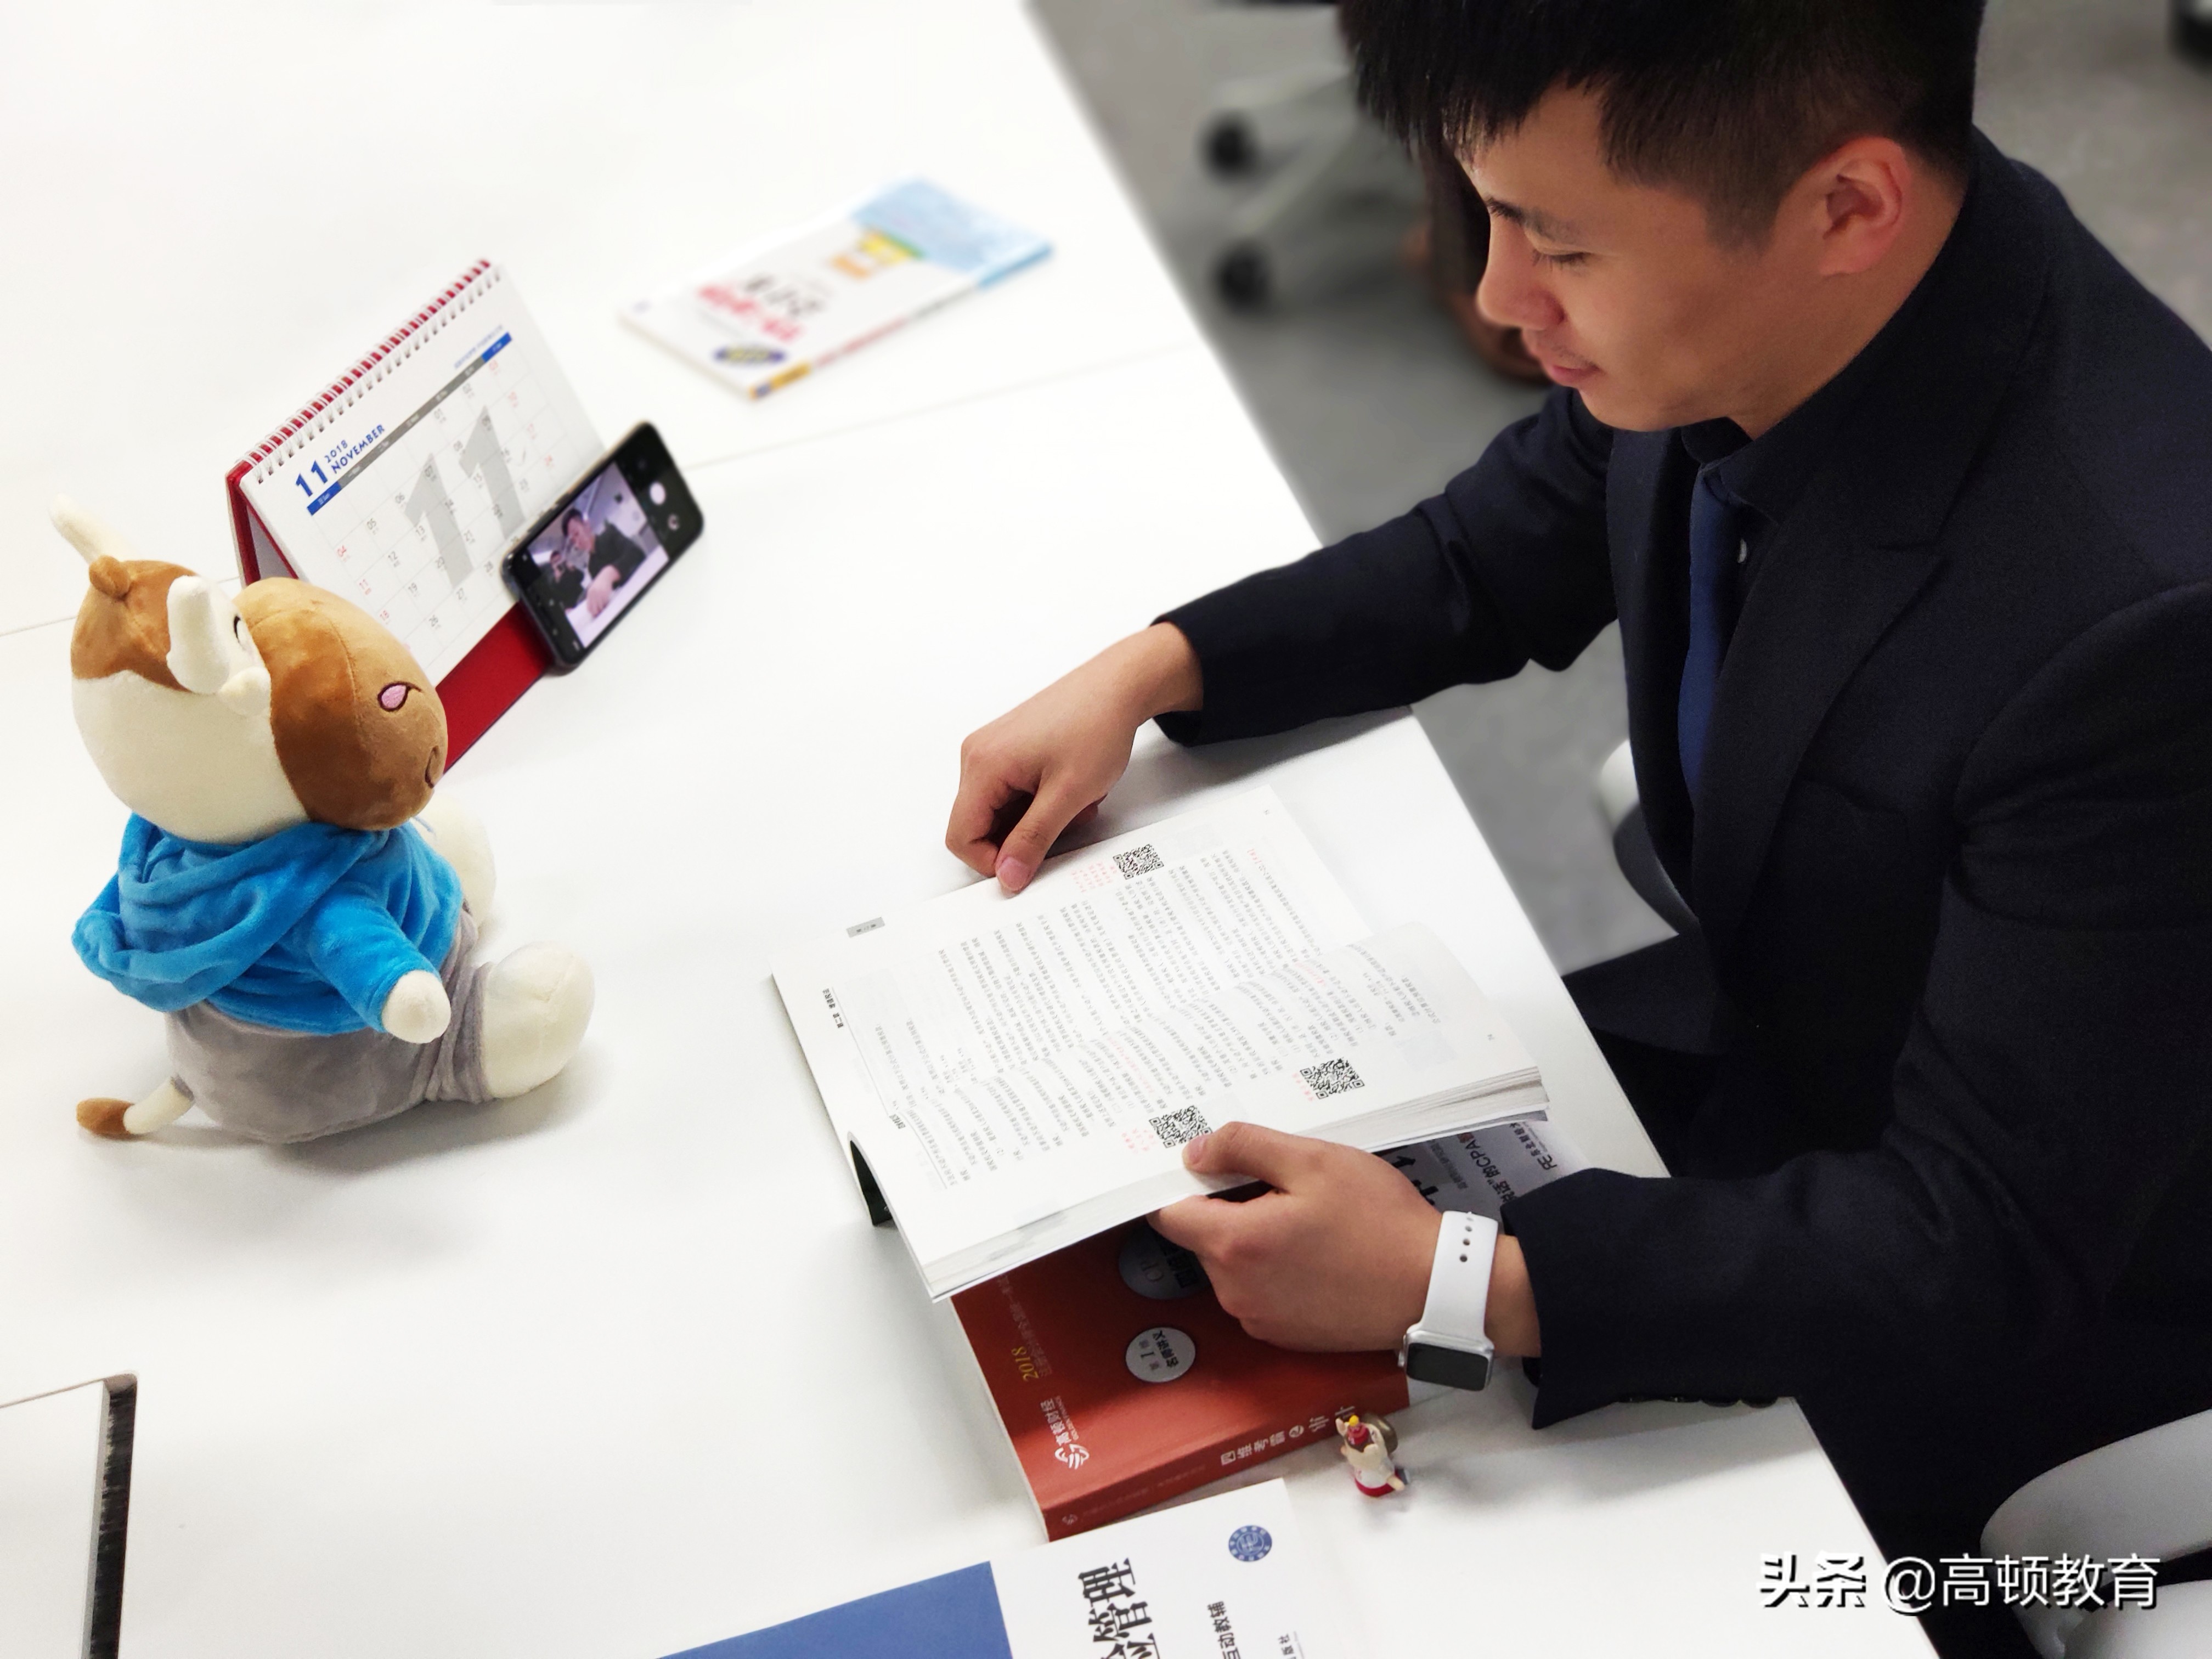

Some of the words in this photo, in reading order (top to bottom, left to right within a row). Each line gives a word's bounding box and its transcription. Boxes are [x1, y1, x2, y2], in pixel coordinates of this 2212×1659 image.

[324, 440, 348, 463] 2018
[331, 425, 385, 473] NOVEMBER
[296, 460, 328, 497] 11
[337, 545, 347, 557] 04
[366, 518, 377, 530] 05
[395, 493, 405, 504] 06
[359, 579, 369, 590] 11
[388, 551, 398, 562] 12
[415, 525, 426, 537] 13
[408, 582, 418, 594] 19
[428, 614, 439, 627] 26
[1011, 1346, 1039, 1381] 2018
[1040, 1399, 1072, 1446] 高顿财经
